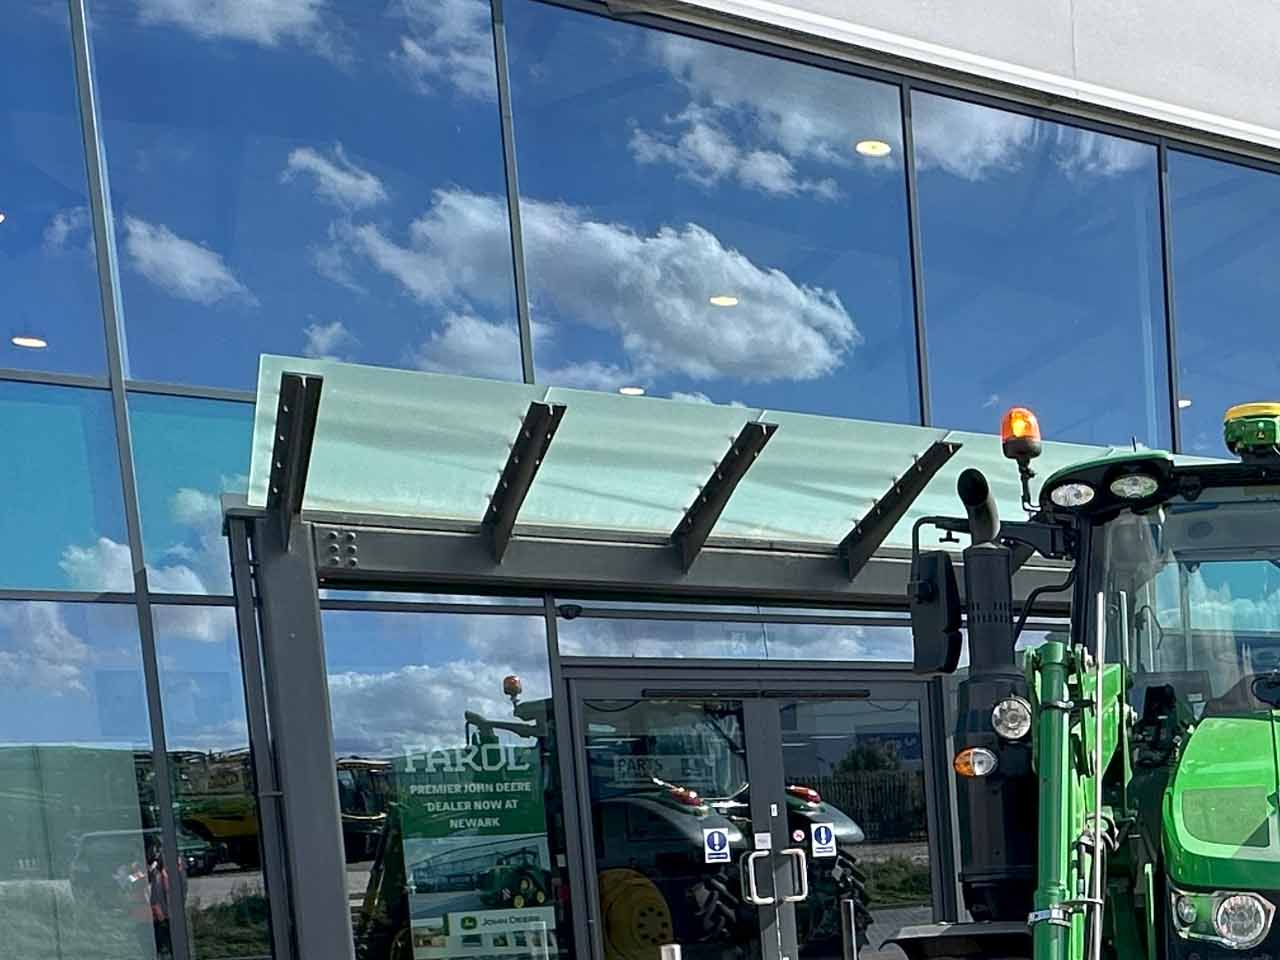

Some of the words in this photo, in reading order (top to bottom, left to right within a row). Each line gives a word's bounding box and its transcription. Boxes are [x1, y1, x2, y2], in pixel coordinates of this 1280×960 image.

[402, 743, 531, 773] FAROL
[409, 783, 461, 795] PREMIER
[464, 782, 493, 793] JOHN
[496, 781, 532, 792] DEERE
[427, 801, 471, 812] DEALER
[474, 800, 502, 810] NOW
[505, 800, 519, 809] AT
[449, 817, 501, 829] NEWARK
